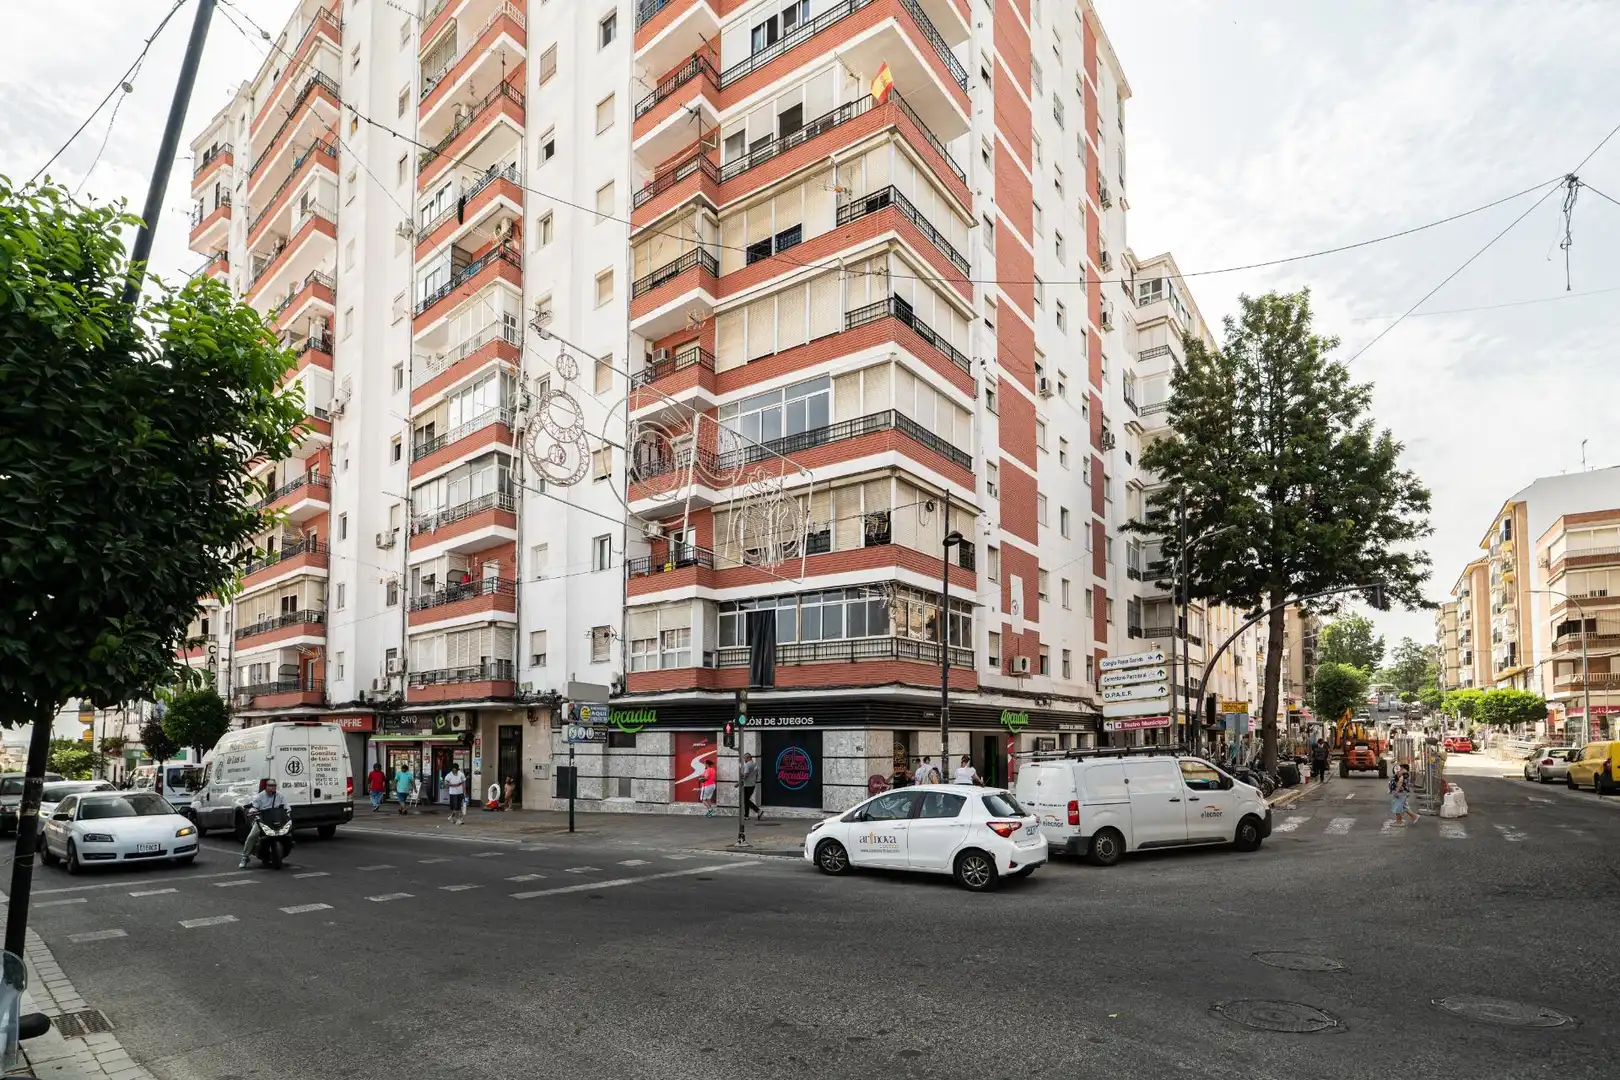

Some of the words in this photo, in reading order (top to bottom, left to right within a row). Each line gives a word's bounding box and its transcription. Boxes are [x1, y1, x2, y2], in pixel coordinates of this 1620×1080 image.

[333, 718, 362, 727] MAPFRE
[609, 703, 657, 733] Arcadia
[764, 718, 776, 726] DE
[777, 717, 814, 725] JUEGOS
[1001, 709, 1028, 733] Arcadia
[1141, 719, 1168, 727] Municipal
